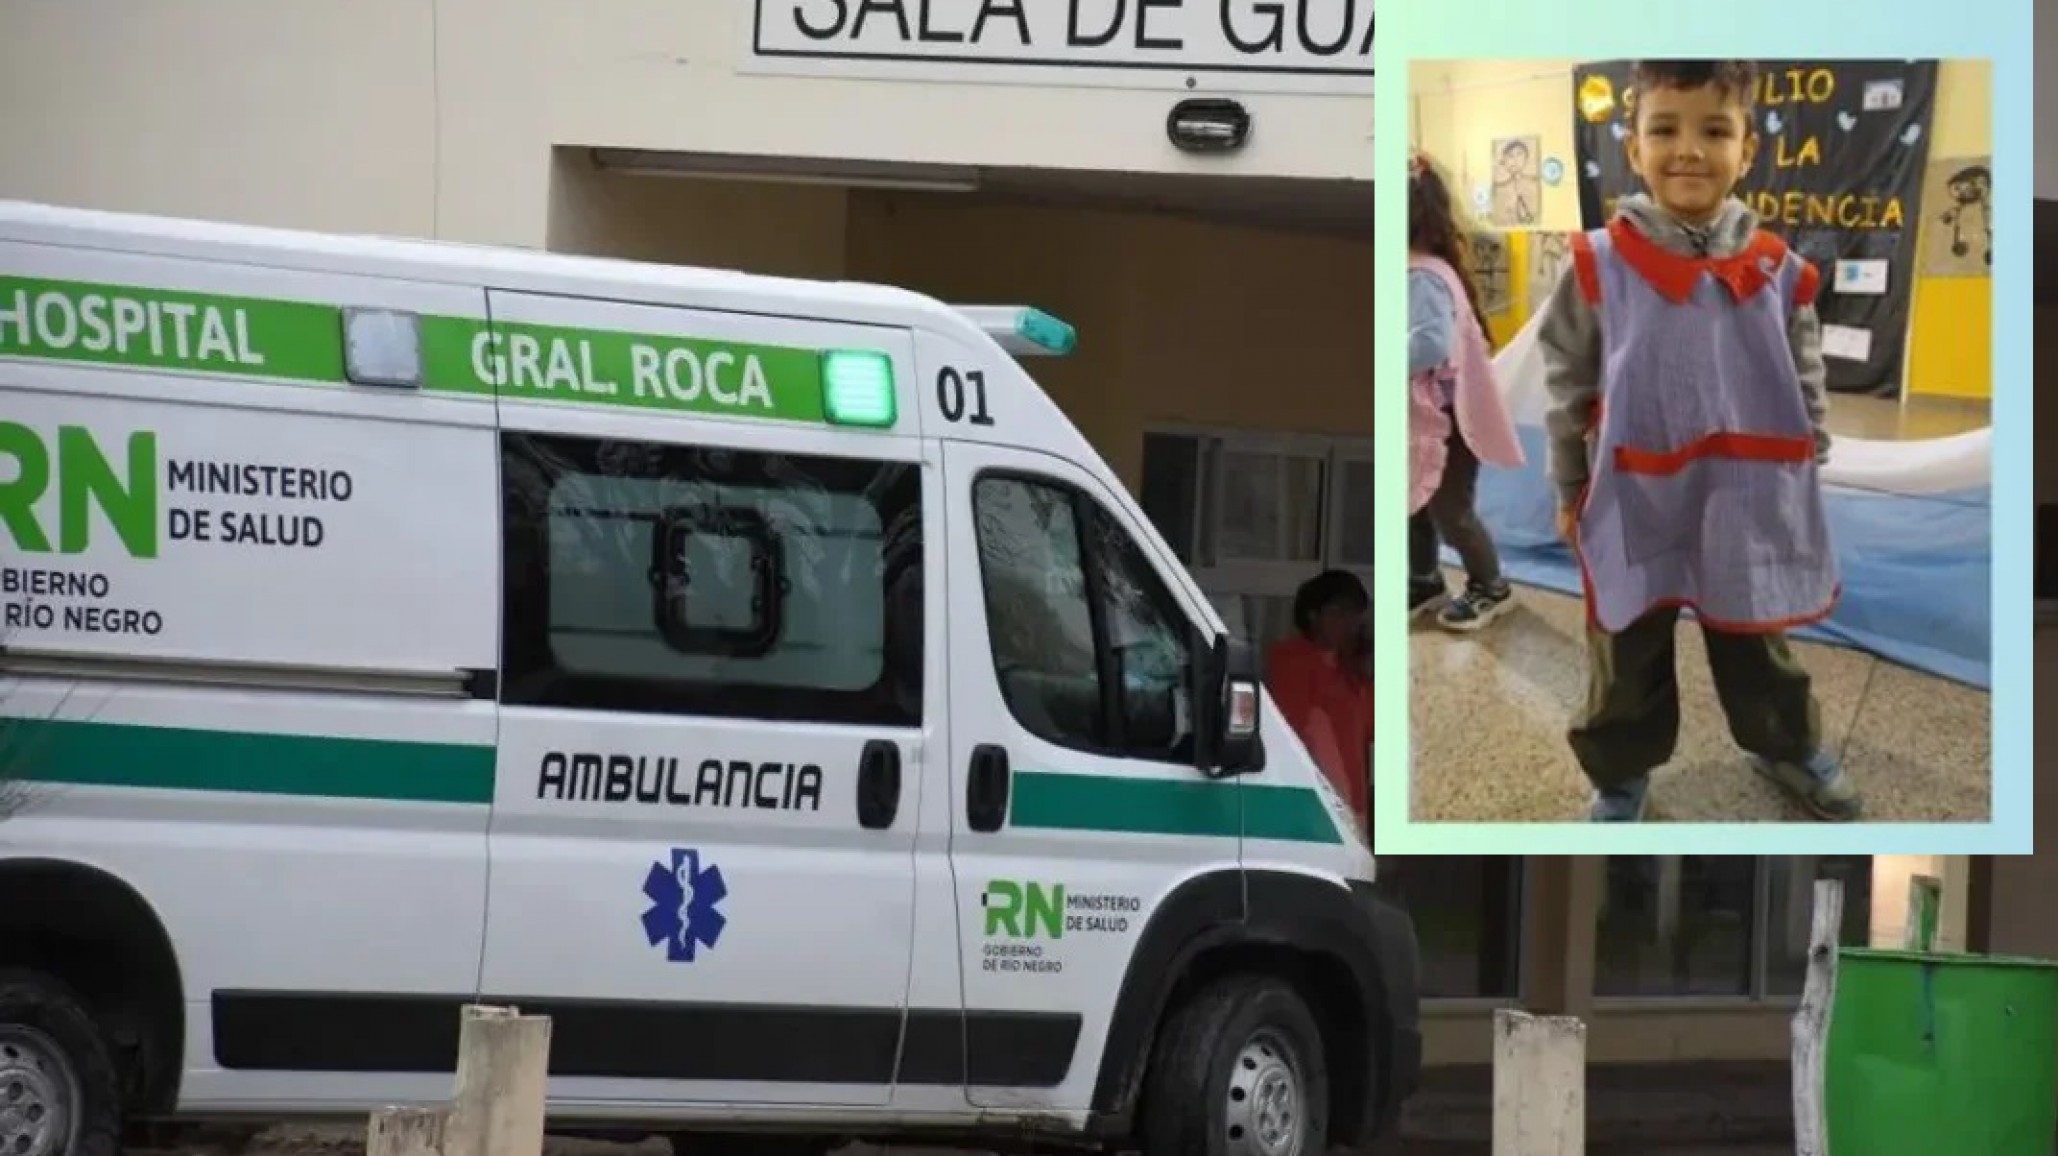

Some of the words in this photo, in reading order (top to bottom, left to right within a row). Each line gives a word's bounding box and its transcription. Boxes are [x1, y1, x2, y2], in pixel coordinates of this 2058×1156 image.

[1219, 0, 1375, 56] GU
[1777, 135, 1820, 168] LA
[0, 289, 265, 364] HOSPITAL
[471, 330, 617, 395] GRAL.
[630, 342, 774, 409] ROCA
[936, 365, 995, 426] 01
[168, 459, 353, 502] MINISTERIO
[168, 508, 211, 541] DE
[220, 511, 324, 547] SALUD
[64, 606, 163, 634] NEGRO
[537, 752, 822, 811] AMBULANCIA
[984, 880, 1064, 939] RN
[1066, 895, 1140, 911] MINISTERIO
[1066, 915, 1083, 931] DE
[1087, 916, 1128, 932] SALUD
[983, 944, 1043, 957] GOBIERNO
